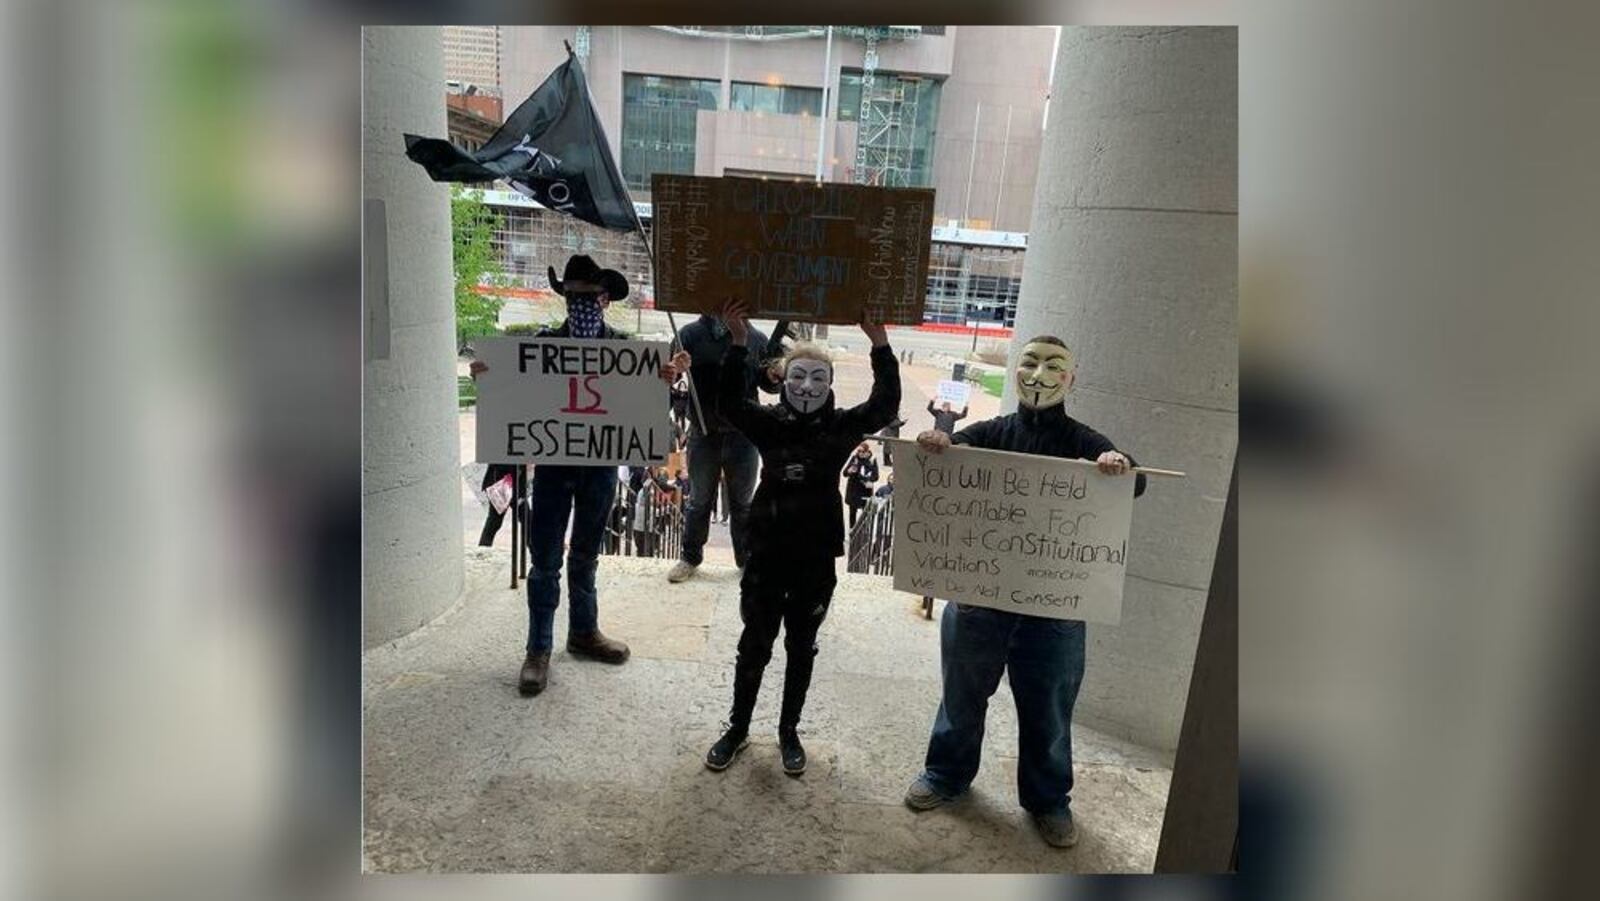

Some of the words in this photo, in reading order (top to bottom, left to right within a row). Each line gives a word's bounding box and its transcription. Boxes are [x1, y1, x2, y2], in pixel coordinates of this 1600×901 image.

[518, 342, 663, 378] FREEDOM
[563, 375, 605, 413] IS
[507, 419, 664, 461] ESSENTIAL
[915, 454, 951, 489] You
[1003, 468, 1030, 496] Be
[1039, 473, 1087, 500] Held
[907, 521, 950, 547] Civil
[1049, 508, 1097, 537] For
[914, 550, 1001, 575] Violations
